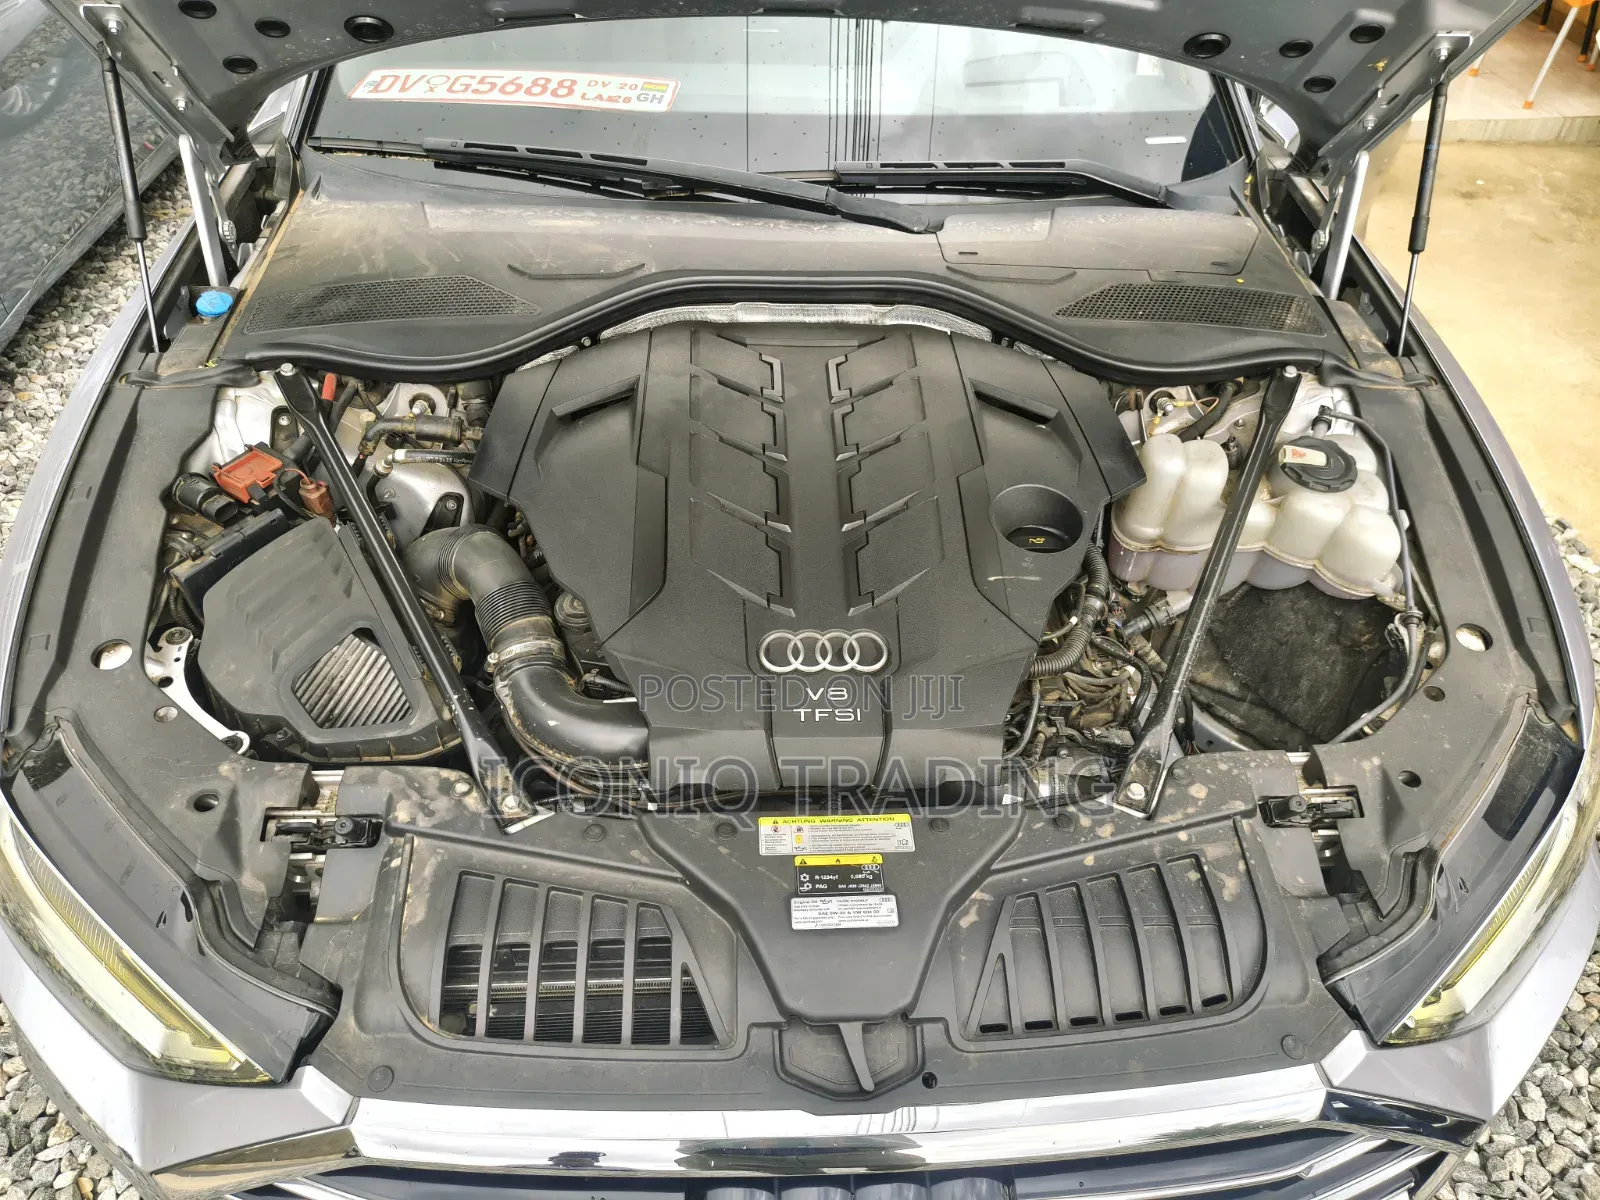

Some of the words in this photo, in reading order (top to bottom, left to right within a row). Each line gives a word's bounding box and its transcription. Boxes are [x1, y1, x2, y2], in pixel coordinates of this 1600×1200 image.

[368, 74, 427, 94] DV
[446, 75, 578, 99] G5688
[586, 79, 612, 88] DV
[617, 82, 638, 91] 20
[636, 92, 665, 105] GH
[792, 708, 862, 723] TFSI
